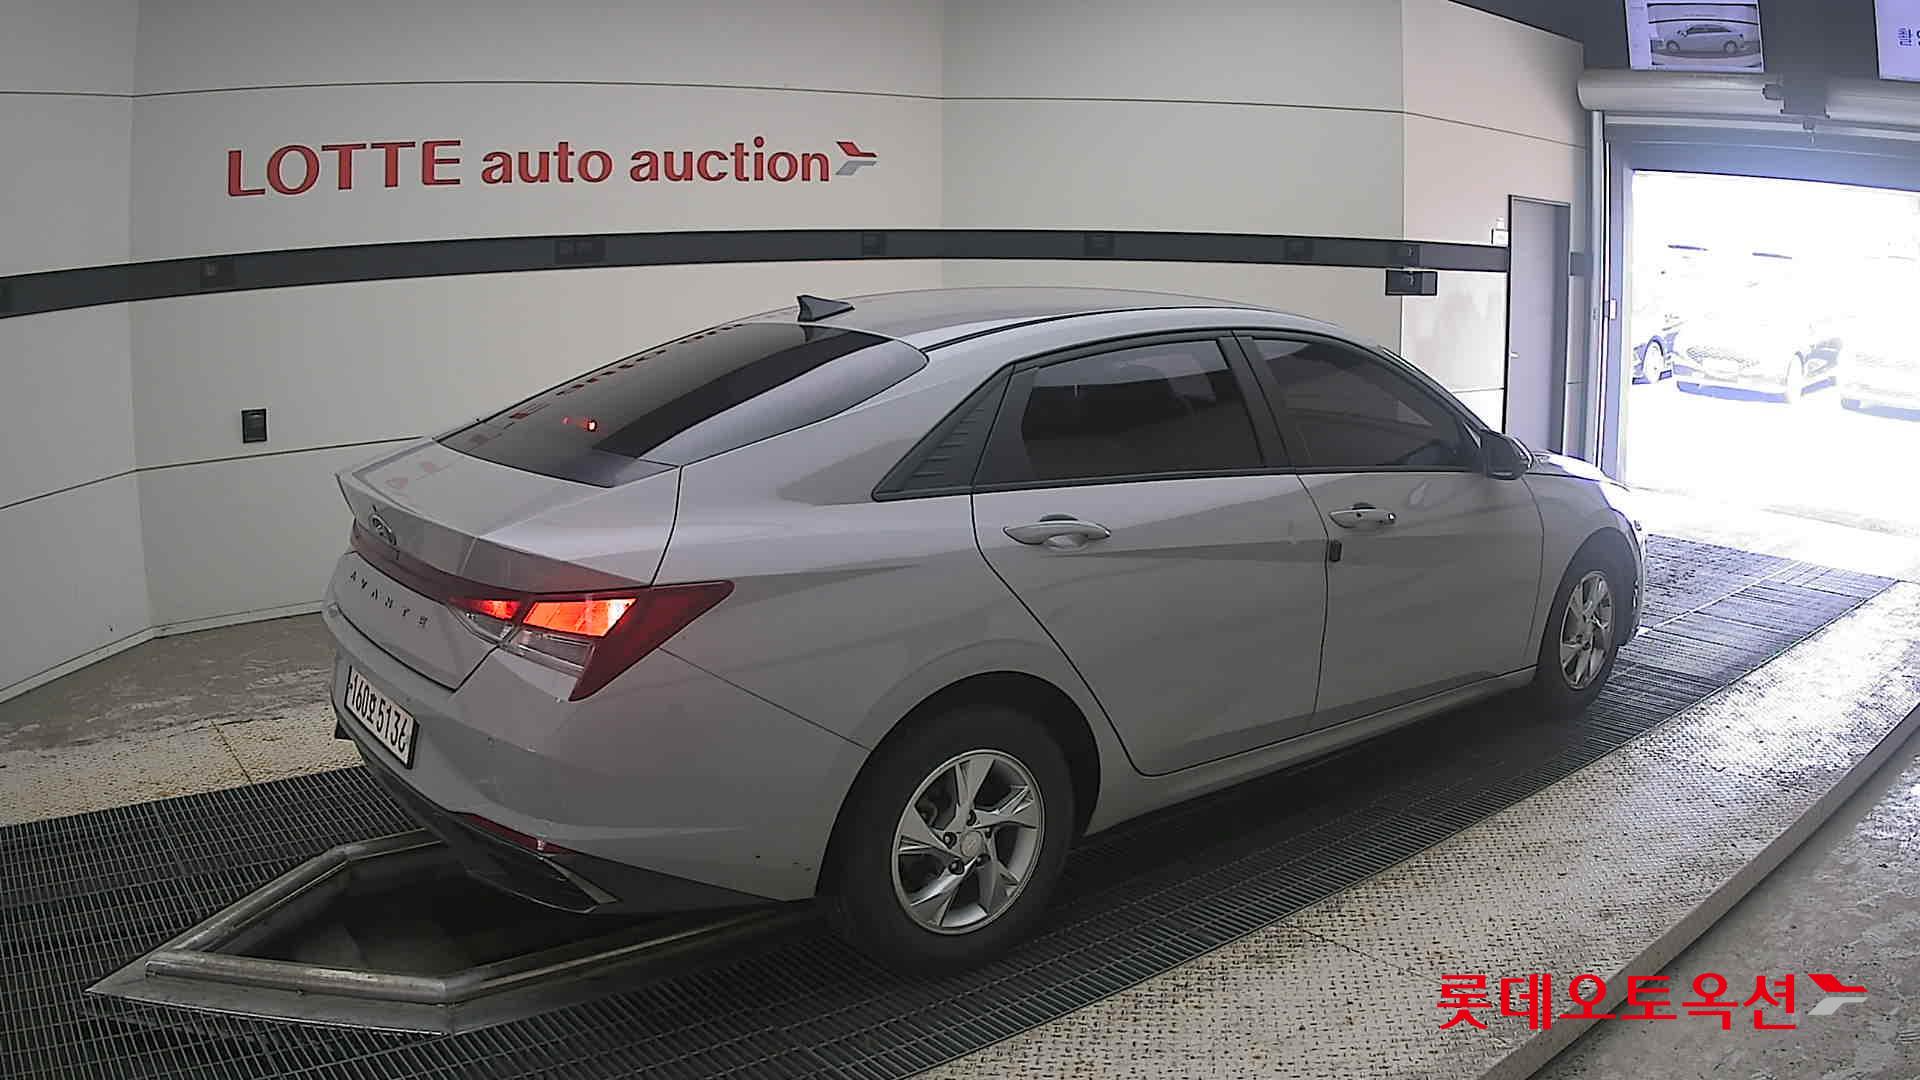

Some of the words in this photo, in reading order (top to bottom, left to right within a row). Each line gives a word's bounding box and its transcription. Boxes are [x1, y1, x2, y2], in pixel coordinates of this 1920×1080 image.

[227, 139, 461, 197] LOTTE
[481, 140, 613, 184] auto
[629, 136, 830, 182] auction
[349, 570, 429, 627] AVANTE
